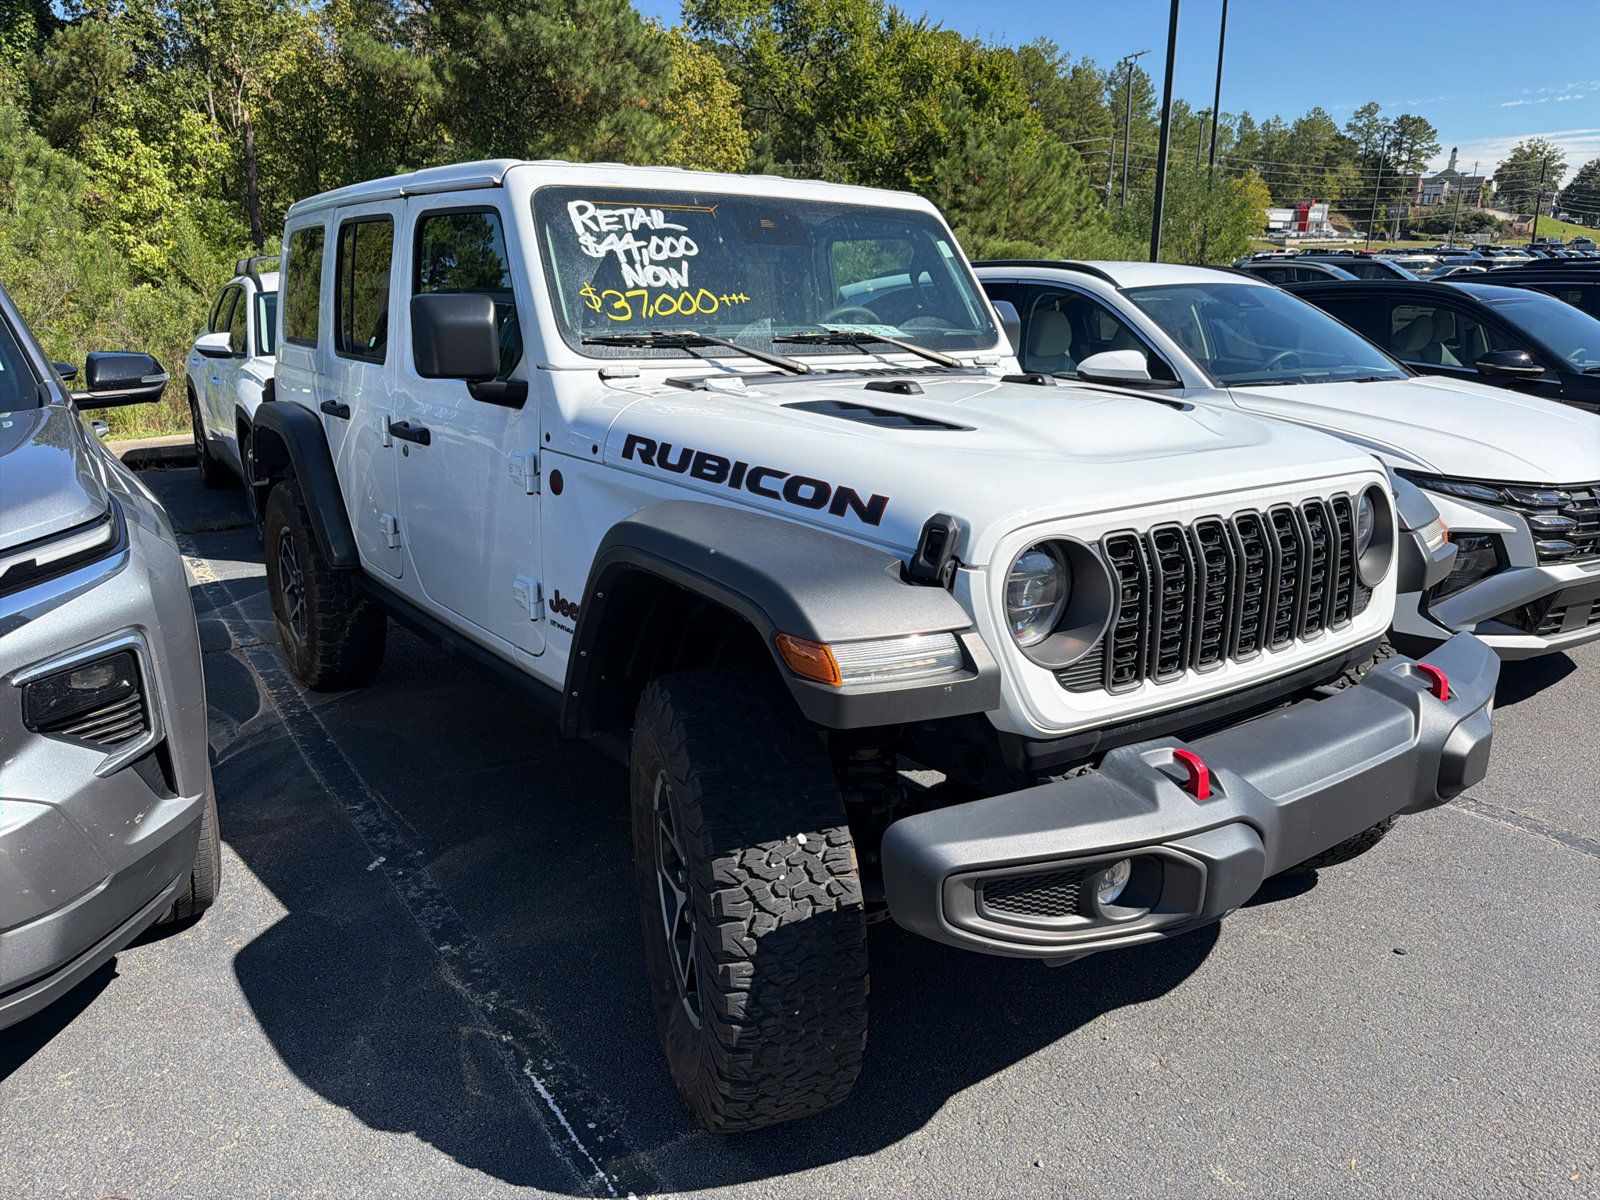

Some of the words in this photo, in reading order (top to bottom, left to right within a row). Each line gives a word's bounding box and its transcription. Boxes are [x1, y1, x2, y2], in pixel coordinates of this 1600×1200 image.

[567, 200, 689, 237] RETAIL
[621, 260, 690, 289] NOW
[621, 433, 890, 527] RUBICON
[549, 589, 580, 622] Jee
